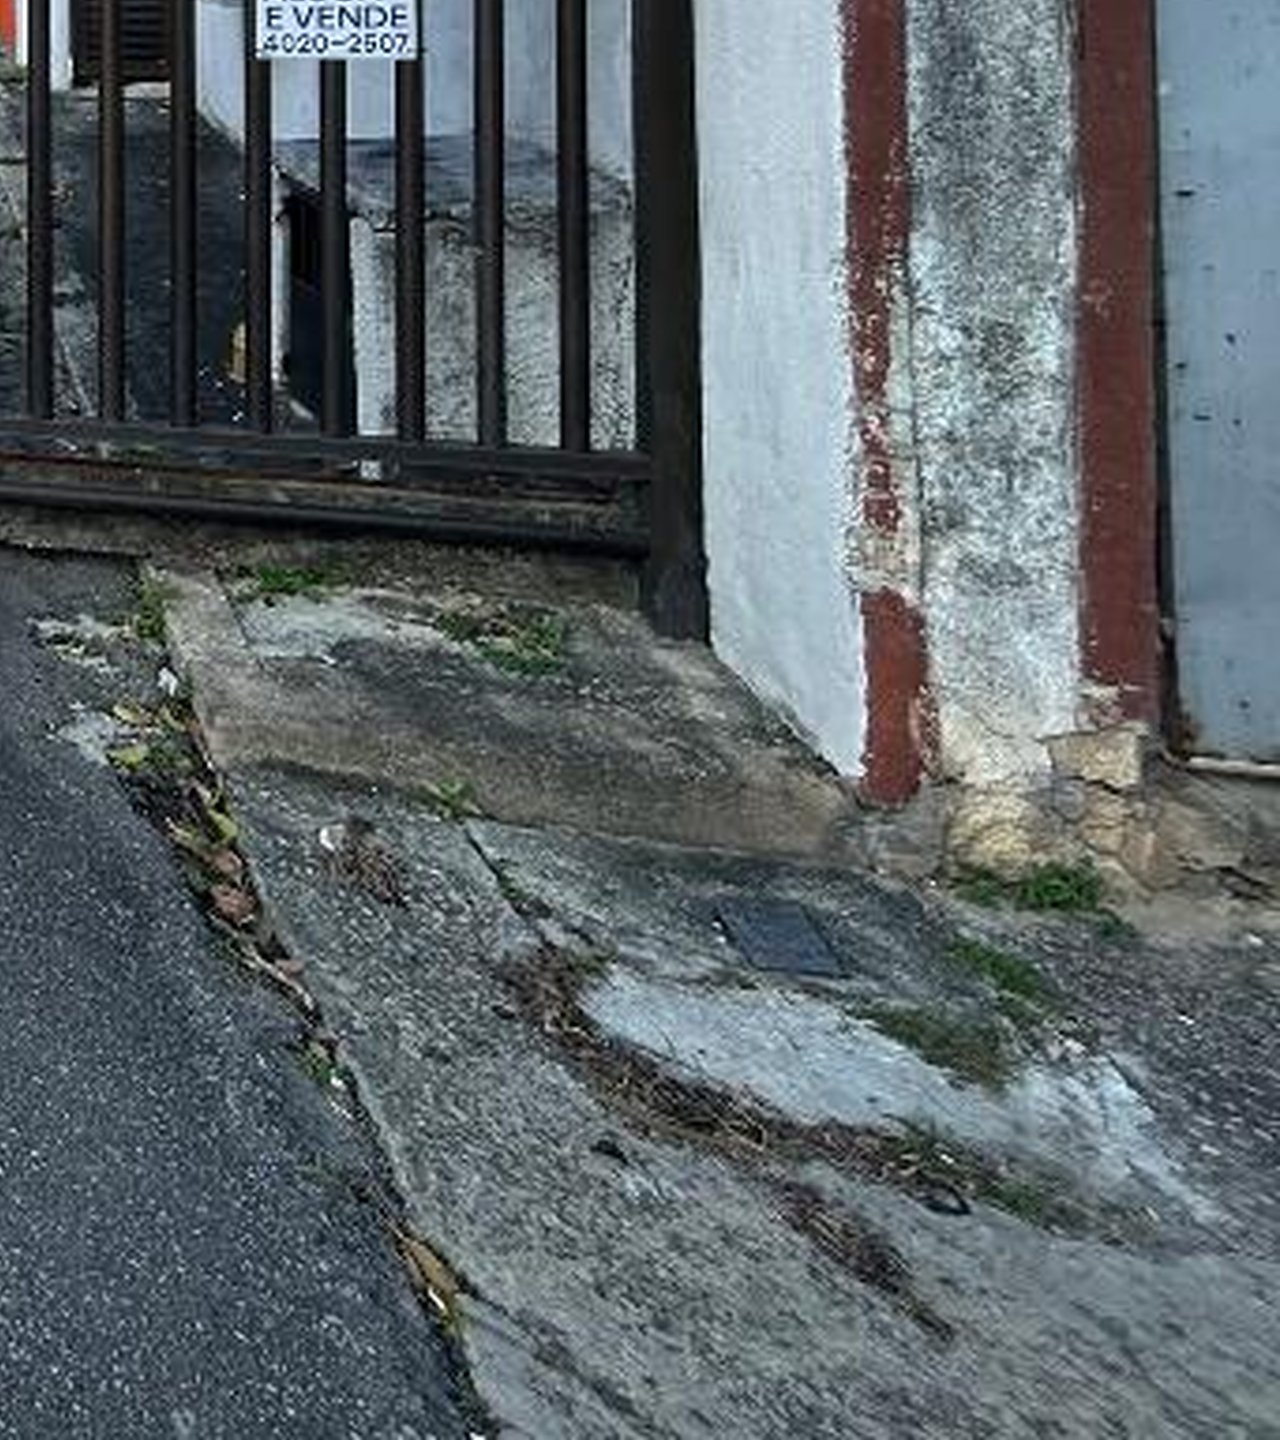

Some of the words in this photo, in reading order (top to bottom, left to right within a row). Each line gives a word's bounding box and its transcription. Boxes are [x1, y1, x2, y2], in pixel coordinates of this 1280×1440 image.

[267, 7, 284, 29] E
[293, 6, 408, 29] VENDE
[263, 33, 409, 54] 4020-2507
